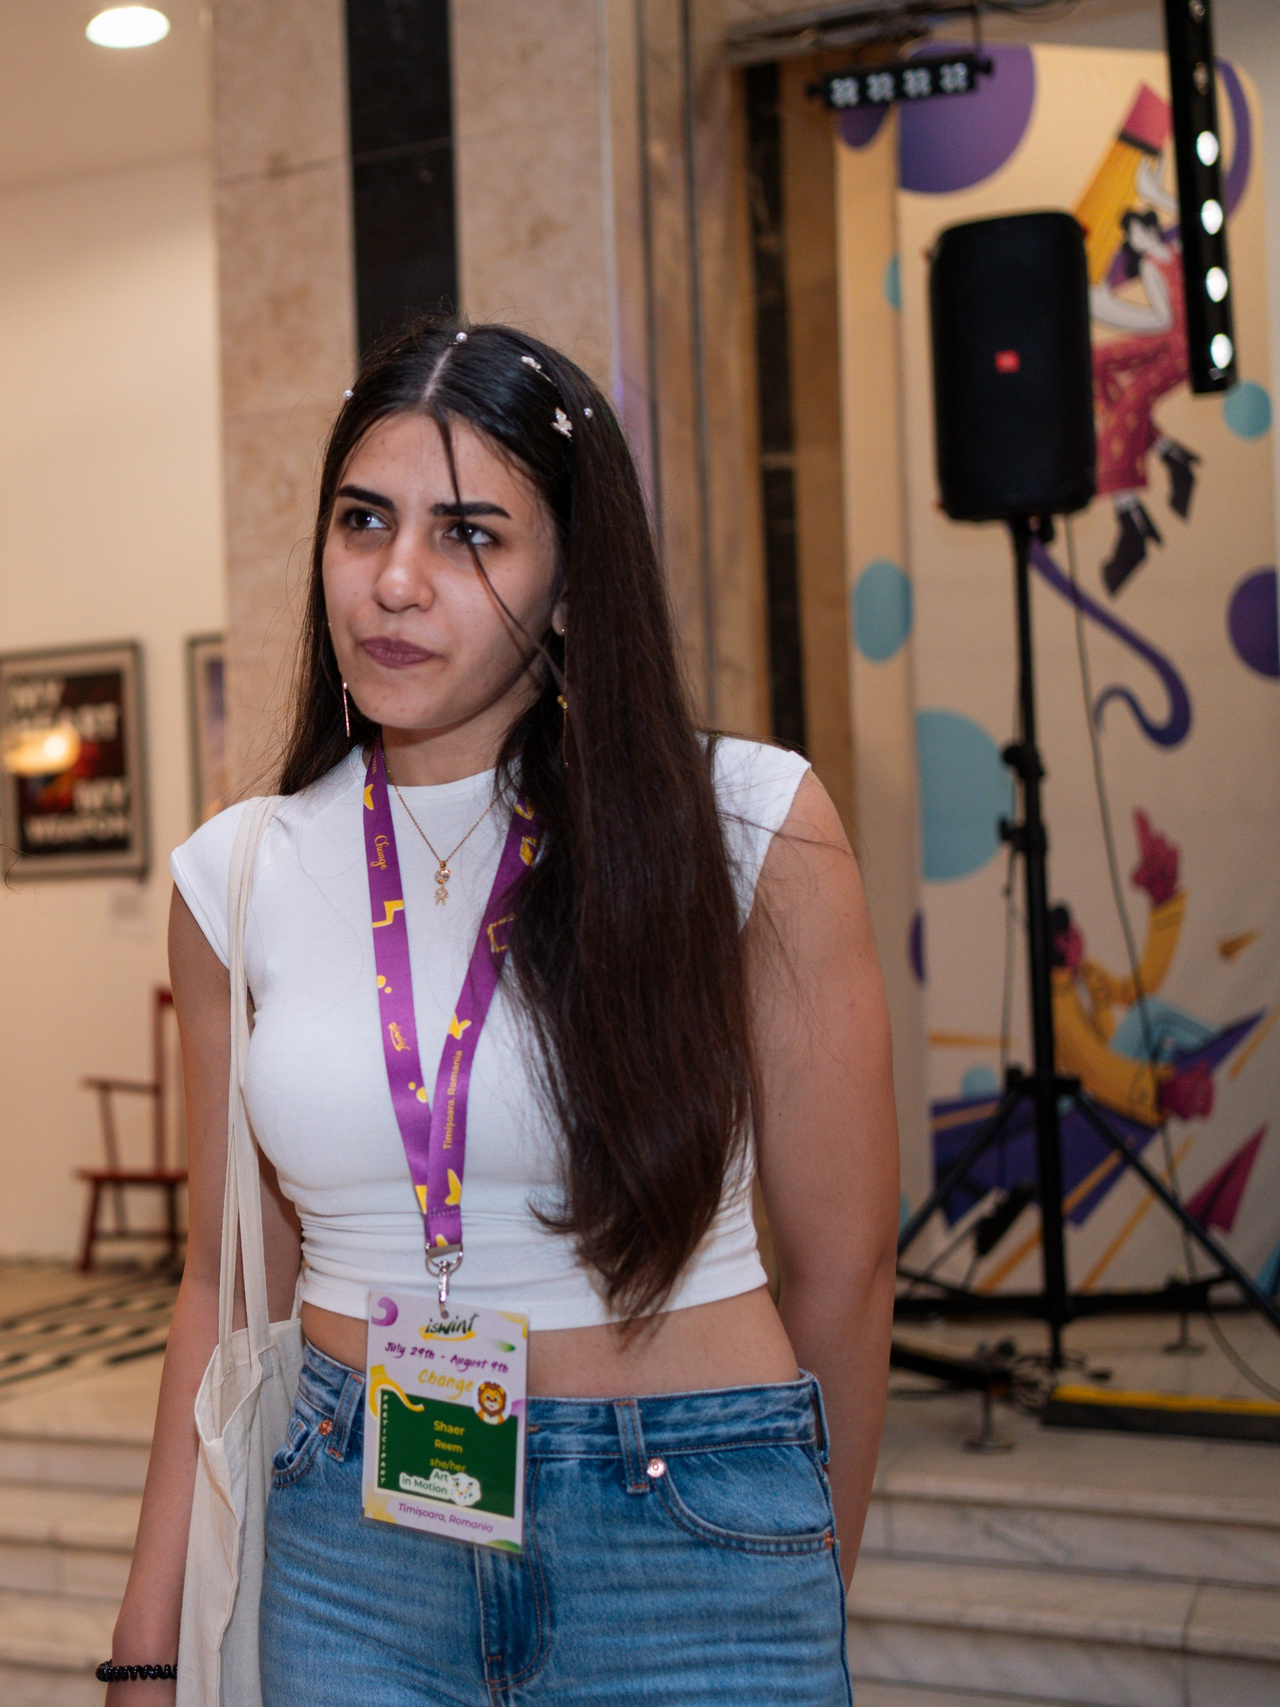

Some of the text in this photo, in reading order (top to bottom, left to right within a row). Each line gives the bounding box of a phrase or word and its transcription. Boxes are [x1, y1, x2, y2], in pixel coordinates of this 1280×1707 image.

[370, 835, 389, 870] Change
[447, 1050, 463, 1095] Romania
[425, 1312, 480, 1335] iswint
[385, 1342, 406, 1358] July
[410, 1346, 435, 1359] 29th
[450, 1354, 488, 1372] August
[491, 1362, 509, 1373] 9th
[418, 1368, 474, 1400] Change
[433, 1420, 465, 1436] Shaer
[434, 1438, 463, 1453] Reem
[402, 1476, 448, 1495] in Motion
[433, 1472, 448, 1482] Art
[449, 1514, 493, 1533] Romania
